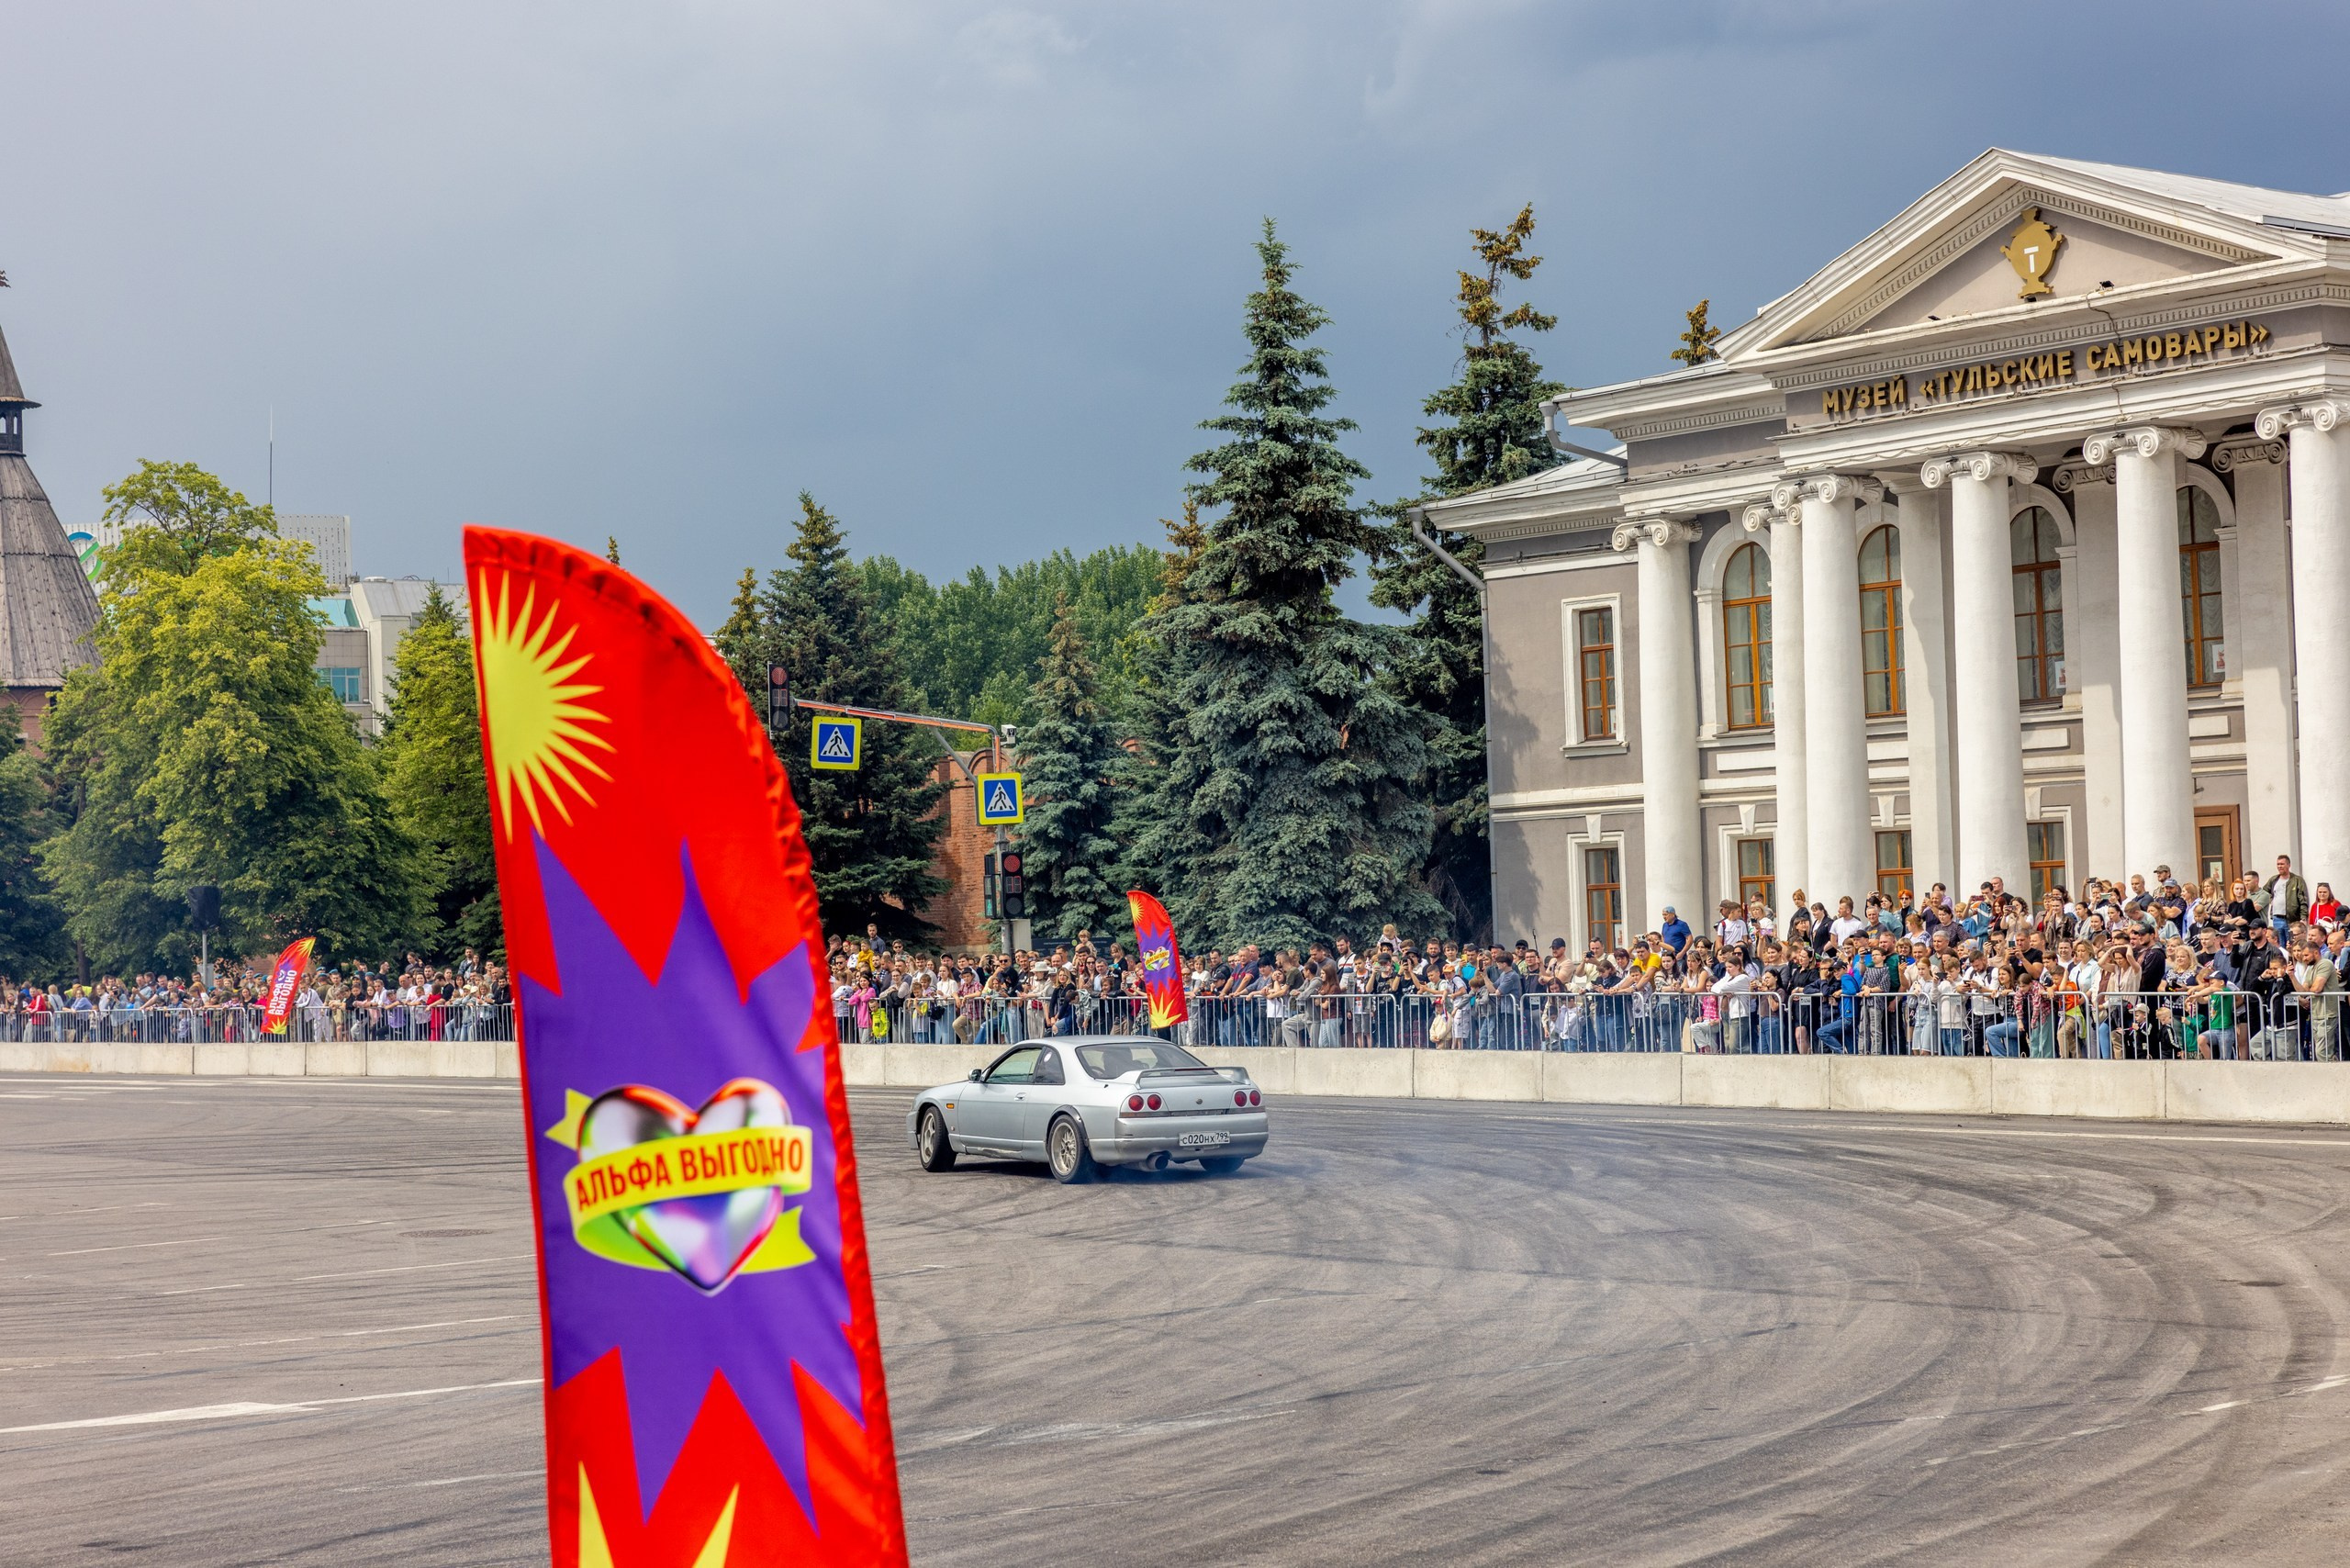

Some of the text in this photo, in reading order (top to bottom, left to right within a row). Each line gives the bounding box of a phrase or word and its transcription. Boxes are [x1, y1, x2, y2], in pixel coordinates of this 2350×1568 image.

[2023, 245, 2040, 274] Т
[1821, 320, 2271, 415] МУЗЕЙ «ТУЛЬСКИЕ САМОВАРЫ»
[268, 982, 284, 1015] АЛЬФА
[274, 969, 297, 1016] ВЫГОДНО
[576, 1137, 804, 1213] АЛЬФА ВЫГОДНО
